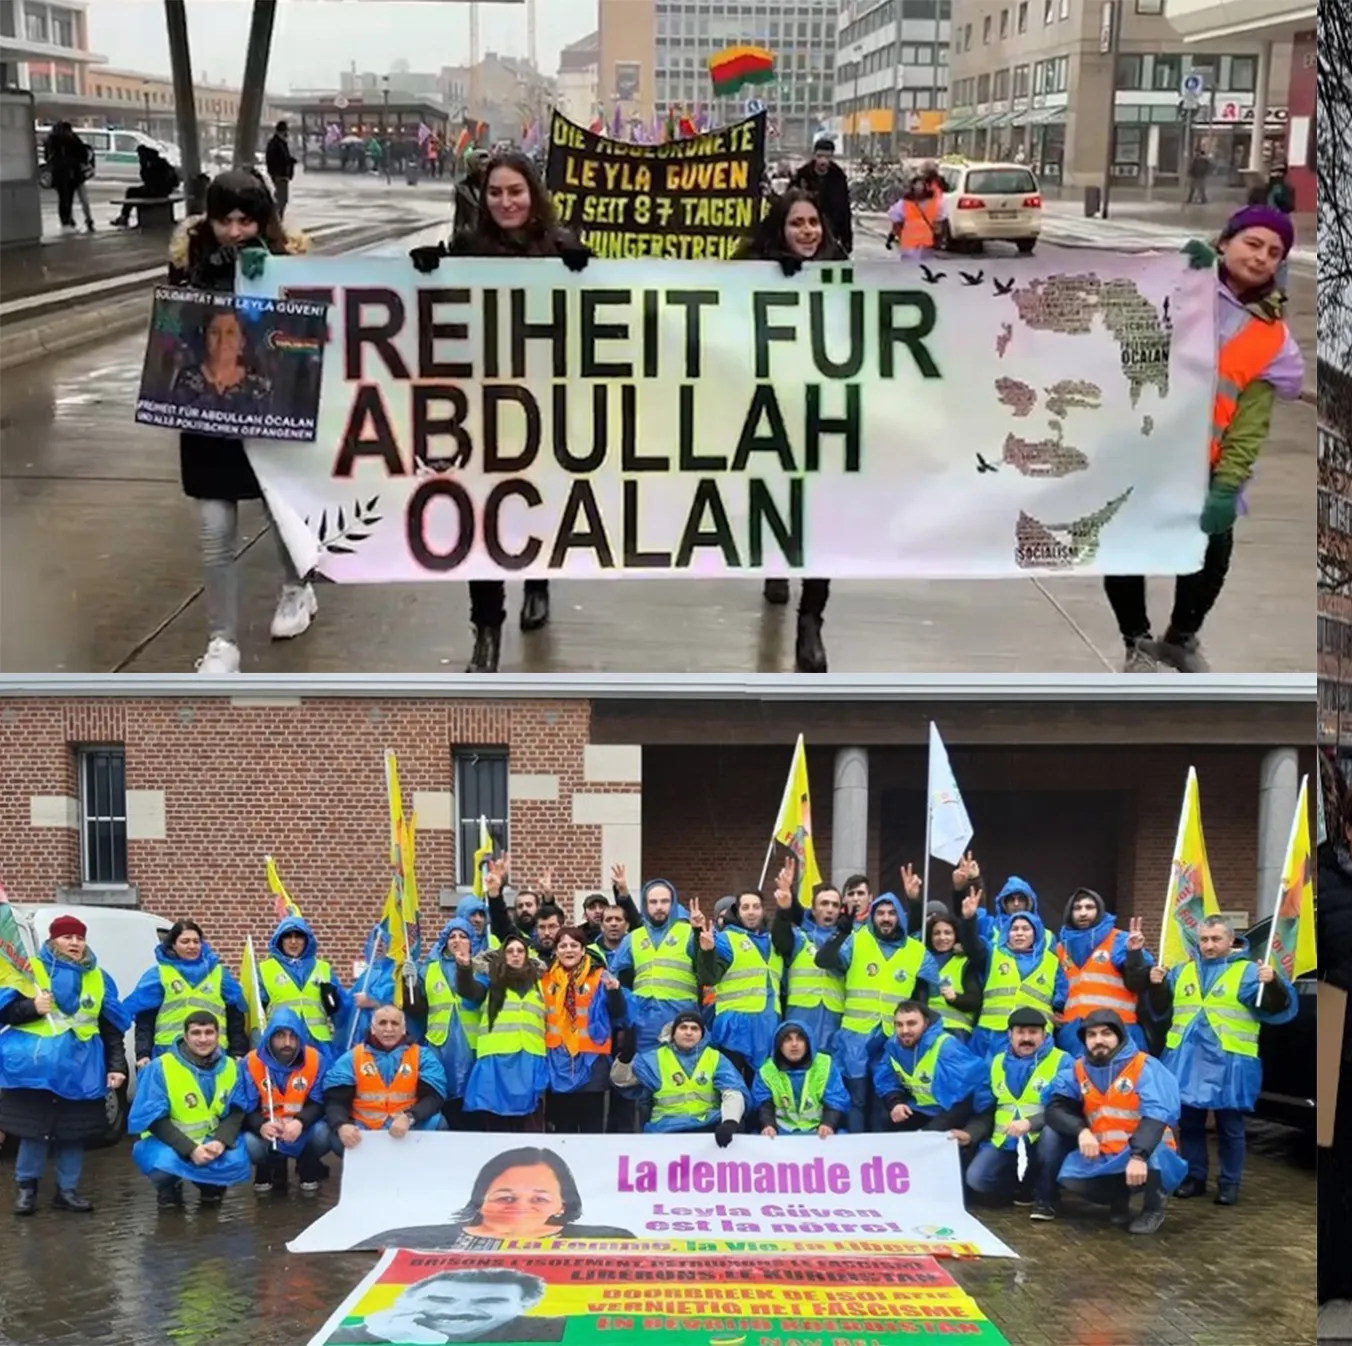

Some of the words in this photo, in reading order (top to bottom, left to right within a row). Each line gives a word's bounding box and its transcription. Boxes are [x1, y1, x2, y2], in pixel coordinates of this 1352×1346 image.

[553, 117, 586, 149] DIE
[565, 156, 652, 192] LEYLA
[582, 194, 629, 225] SEIT
[680, 197, 752, 228] TAGEN
[214, 296, 232, 307] MIT
[234, 297, 275, 312] LEYLA
[276, 301, 325, 316] GÜVEN!
[753, 269, 943, 380] FÜR
[331, 383, 862, 477] ABDULLAH
[617, 1155, 658, 1193] La
[667, 1154, 852, 1195] demande
[860, 1155, 911, 1195] de
[652, 1203, 752, 1218] Leyla
[761, 1203, 883, 1218] Güven
[645, 1220, 713, 1232] est
[720, 1219, 762, 1233] la
[602, 1288, 777, 1300] DOORBREEK
[782, 1289, 818, 1301] DE
[812, 1302, 971, 1318] FASCISME
[597, 1317, 634, 1330] EN
